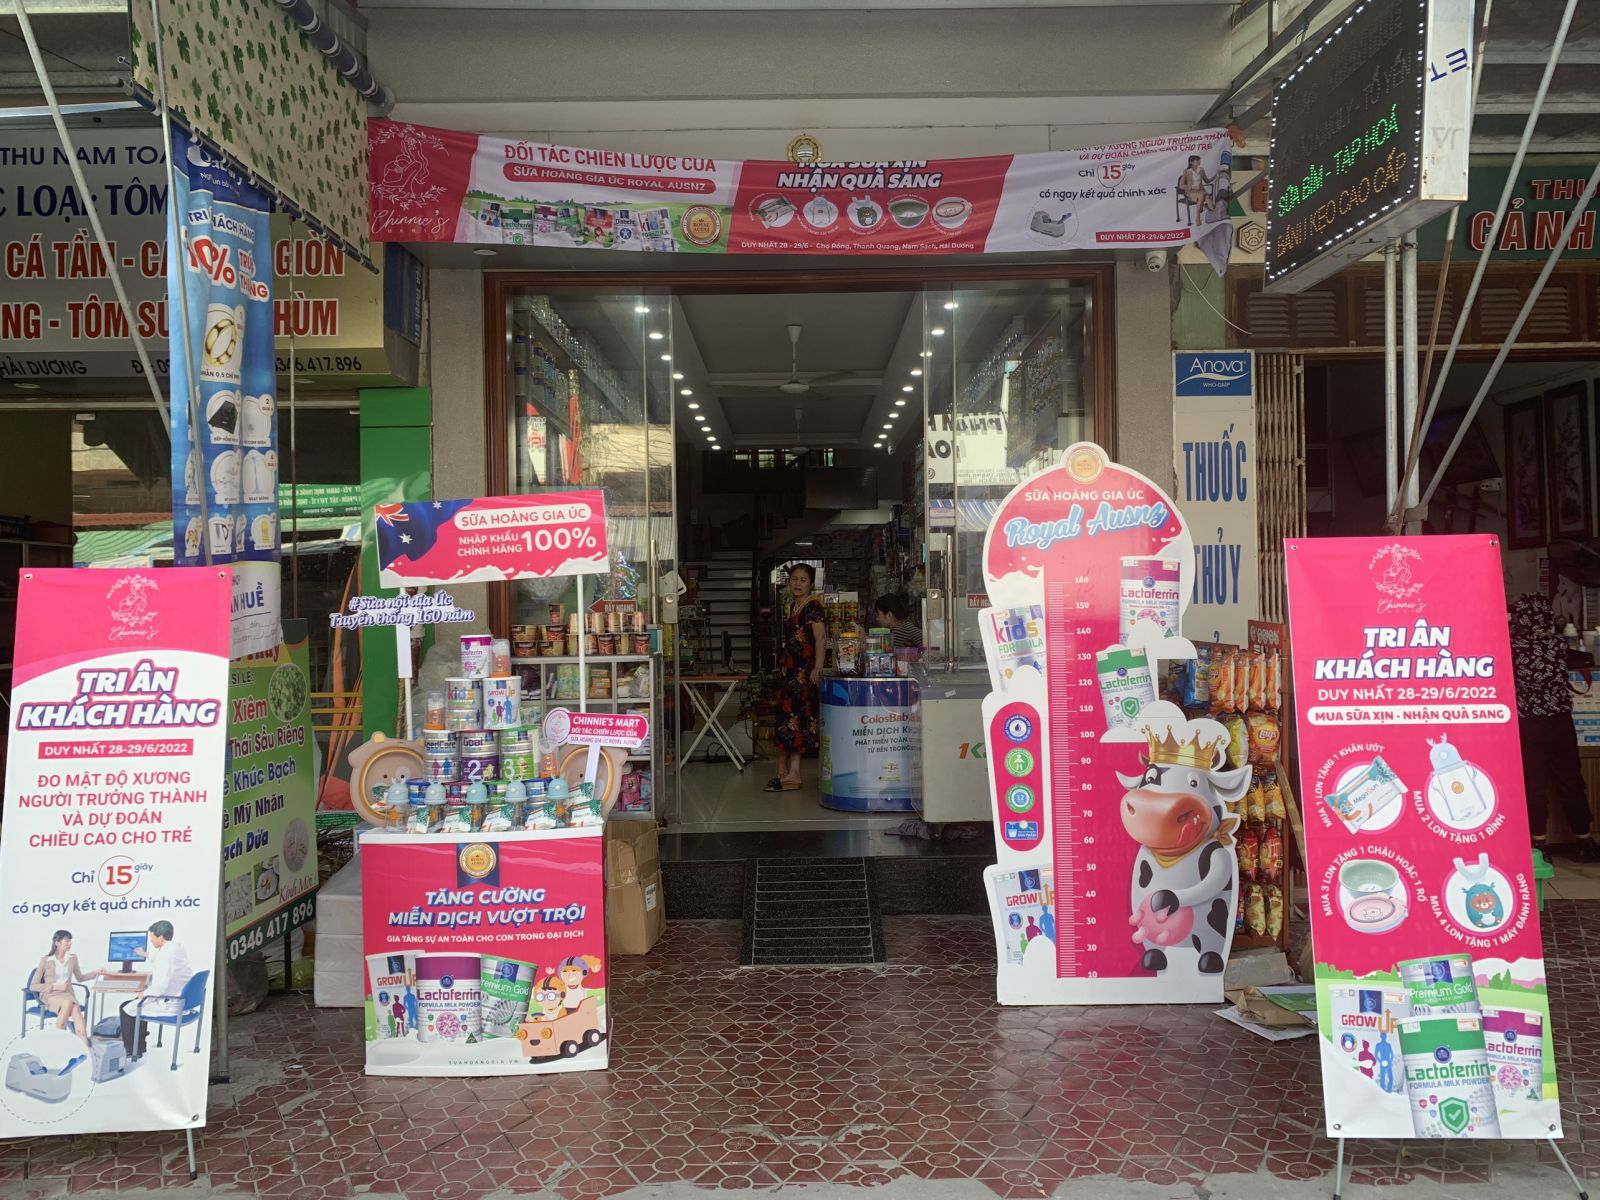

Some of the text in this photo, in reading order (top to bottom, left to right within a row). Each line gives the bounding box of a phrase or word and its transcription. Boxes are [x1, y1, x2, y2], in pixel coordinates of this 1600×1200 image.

[0, 146, 116, 165] THU NAM
[777, 168, 838, 193] NHẬN
[1102, 164, 1122, 180] 15
[586, 174, 606, 184] GIA
[608, 173, 626, 185] ÚC
[628, 178, 664, 189] ROYAL
[668, 181, 706, 192] AUSNZ
[1039, 187, 1051, 199] có
[1053, 190, 1078, 202] ngay
[1147, 186, 1167, 196] xác
[1471, 198, 1597, 251] CẢNH
[1100, 231, 1185, 242] DUY NHẤT 28-29/6/2022
[6, 228, 116, 279] CÁ TẦM
[276, 231, 346, 277] GIÒN
[66, 294, 132, 339] TÔM
[1190, 357, 1244, 373] Anova
[1183, 424, 1247, 502] THUỐC
[1025, 487, 1144, 501] SỮA HOÀNG GIA ÚC
[461, 506, 586, 527] SỮA HOÀNG GIA ÚC
[1004, 500, 1171, 549] Royal Ausnz
[458, 530, 519, 546] NHẬP KHẨU
[521, 527, 597, 552] 100%
[457, 542, 522, 557] CHÍNH HÃNG
[1193, 527, 1241, 605] THỦY
[1074, 576, 1089, 584] 160
[1121, 587, 1180, 599] Lactoferrin
[416, 609, 442, 623] 160
[443, 609, 475, 622] năm
[991, 613, 1038, 644] kids
[1076, 627, 1091, 635] 140
[1363, 618, 1451, 648] TRI ÂN
[1314, 648, 1494, 680] KHÁCH HÀNG
[79, 661, 176, 694] TRI ÂN
[1317, 684, 1497, 701] DUY NHẤT 28-29/6/2022
[18, 692, 218, 728] KHÁCH HÀNG
[232, 696, 269, 724] Xiêm
[1315, 706, 1504, 724] MUA SỮA XỊN NHẬN QUÀ SANG
[573, 716, 640, 727] CHINNIE'S MART
[254, 725, 274, 753] Sầu
[277, 722, 305, 748] Riêng
[876, 726, 900, 738] DỊCH
[44, 742, 188, 756] DUY NHẤT 28-29/6/2022
[38, 770, 191, 789] ĐO MẬT ĐỘ XƯƠNG
[234, 756, 297, 793] Khúc Bạch
[1082, 783, 1092, 791] 80
[255, 792, 284, 818] Nhãn
[29, 826, 192, 847] CHIỀU CAO CHO TRẺ
[1086, 863, 1096, 871] 50
[425, 886, 546, 906] TĂNG CƯỜNG
[1006, 893, 1038, 906] GROW
[388, 903, 586, 929] MIỄN DỊCH VƯỢT TRỘI
[230, 898, 314, 962] 0346 417 896
[387, 935, 400, 943] GIA
[402, 934, 424, 943] TĂNG
[425, 934, 436, 944] SỰ
[437, 935, 449, 943] AN
[451, 933, 474, 943] TOÀN
[495, 934, 514, 942] CON
[546, 932, 562, 940] ĐẠI
[563, 930, 584, 939] DỊCH
[377, 976, 402, 987] GROW
[1410, 981, 1474, 998] Premium Gold
[417, 989, 482, 1001] Lactoferrin
[1405, 1059, 1491, 1081] Lactoferrin
